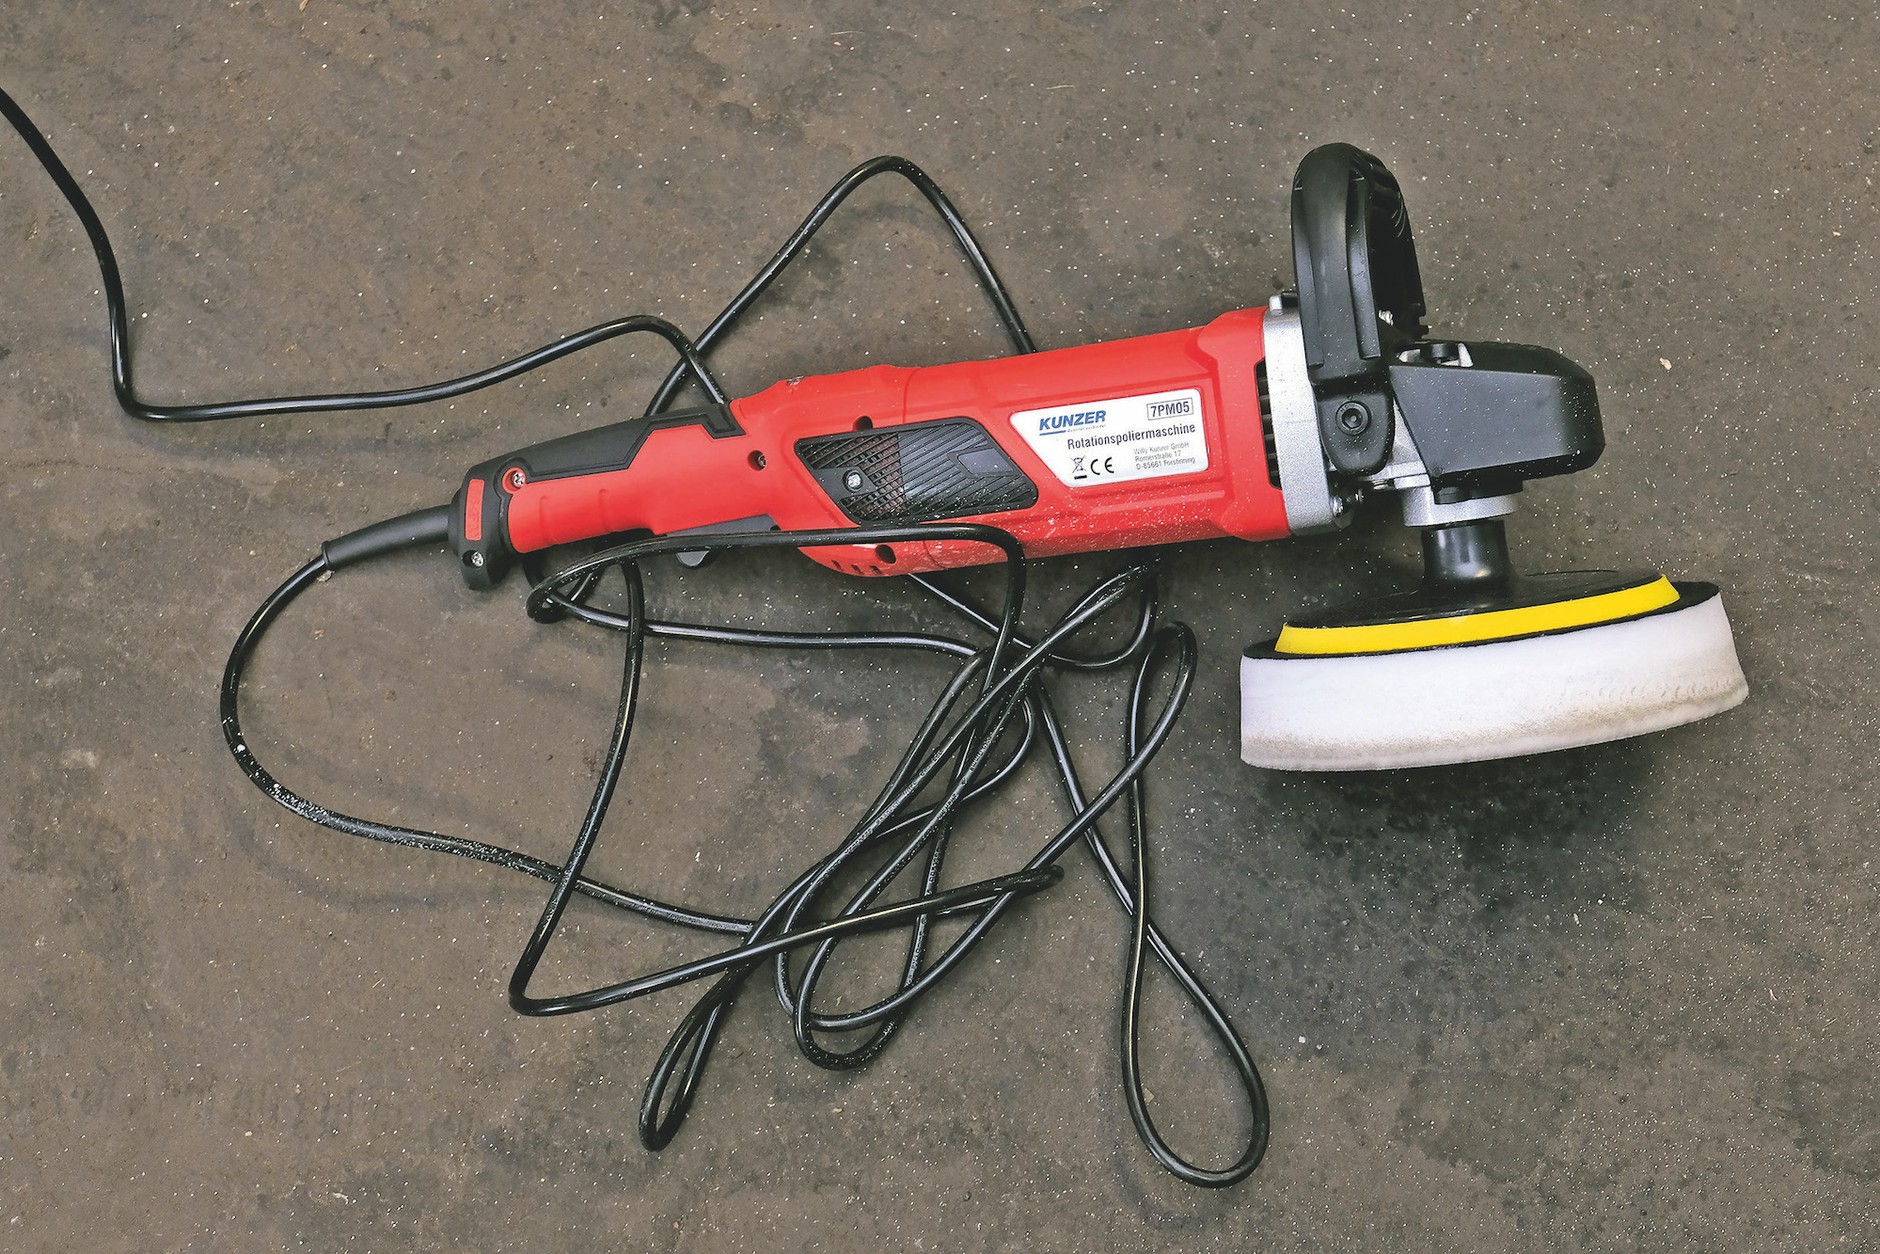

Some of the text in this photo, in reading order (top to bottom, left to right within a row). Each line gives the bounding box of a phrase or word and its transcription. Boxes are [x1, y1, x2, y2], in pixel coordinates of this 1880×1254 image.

[1150, 401, 1190, 418] 7PM05
[1039, 410, 1107, 431] KUNZER
[1067, 423, 1196, 450] Rotationspoliermaschine
[1170, 442, 1190, 450] GmbH
